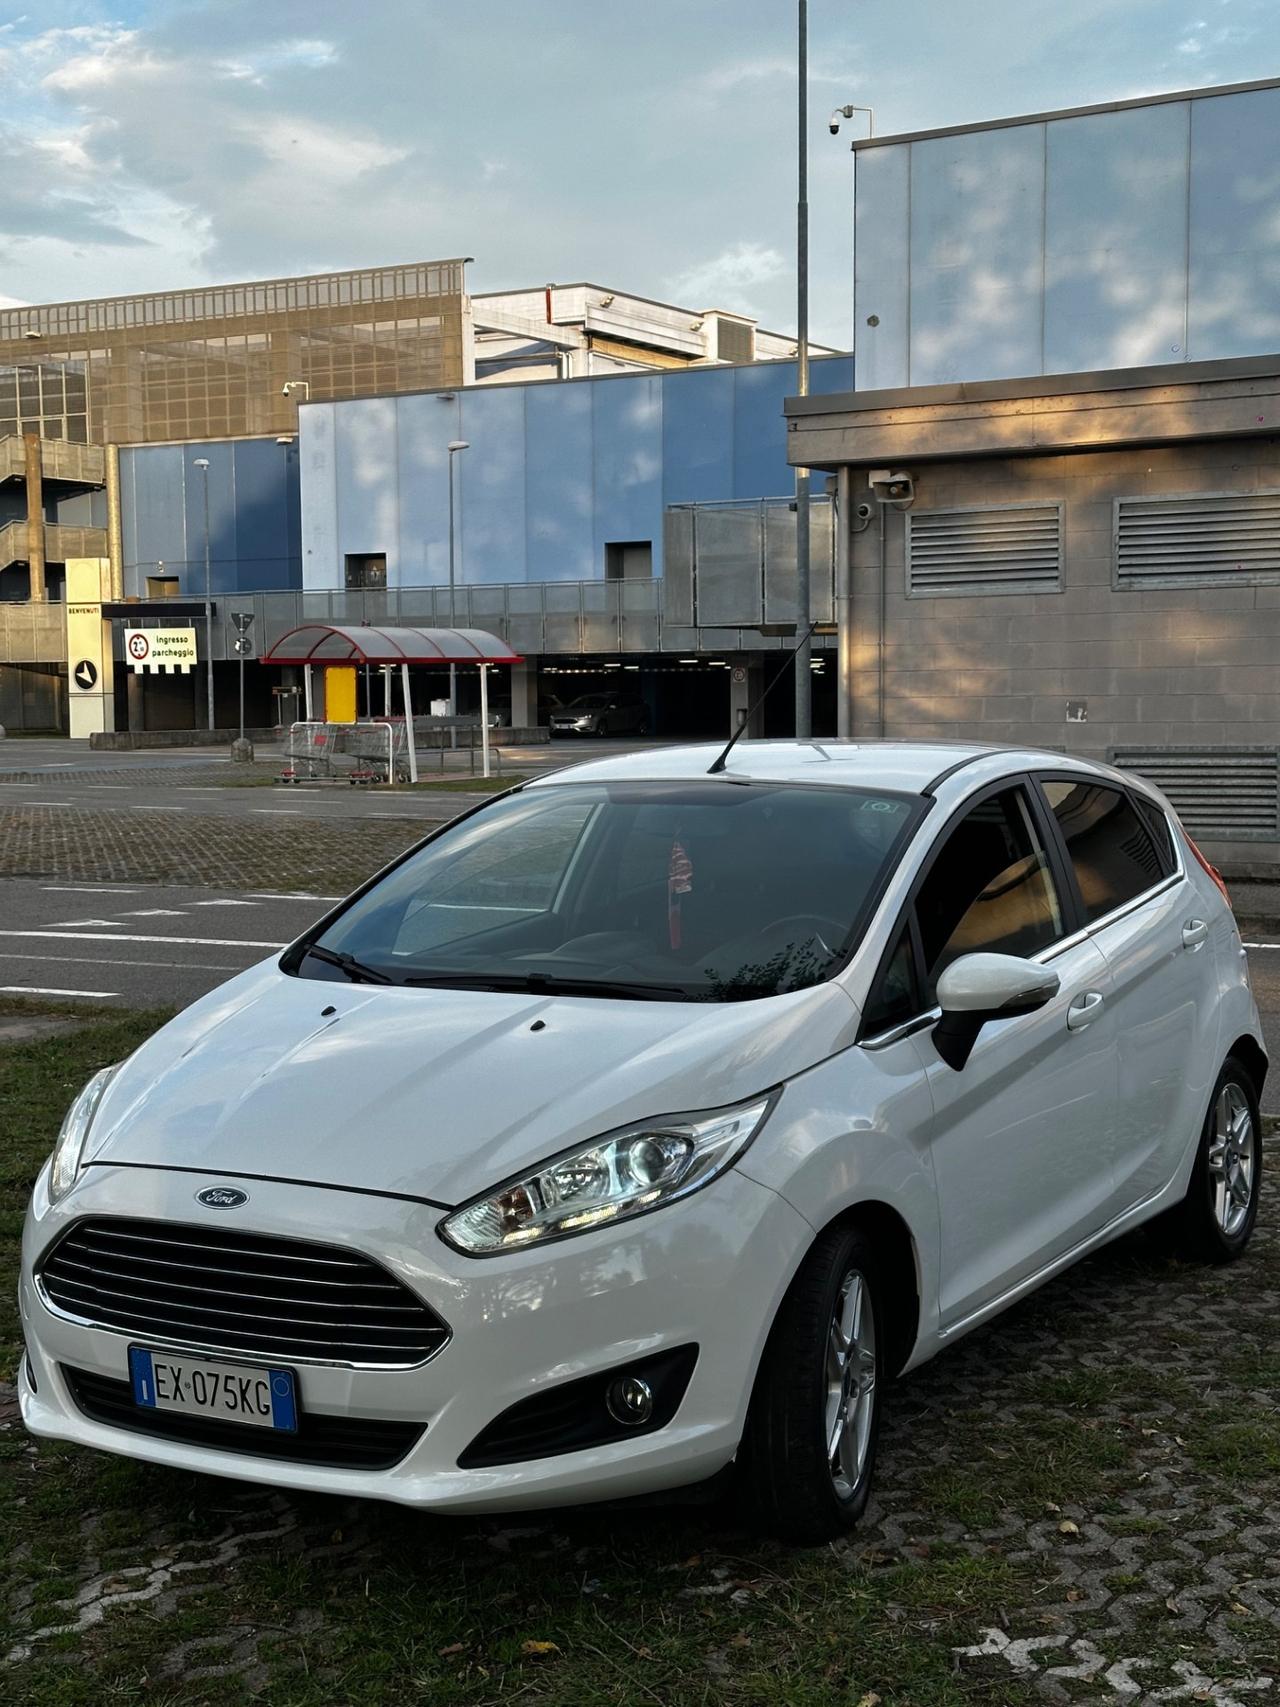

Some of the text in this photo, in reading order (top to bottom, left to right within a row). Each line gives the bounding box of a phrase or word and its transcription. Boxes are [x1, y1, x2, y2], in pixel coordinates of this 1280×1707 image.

[156, 635, 189, 645] ingresso
[152, 648, 195, 658] parcheggio
[206, 1189, 238, 1204] Ford
